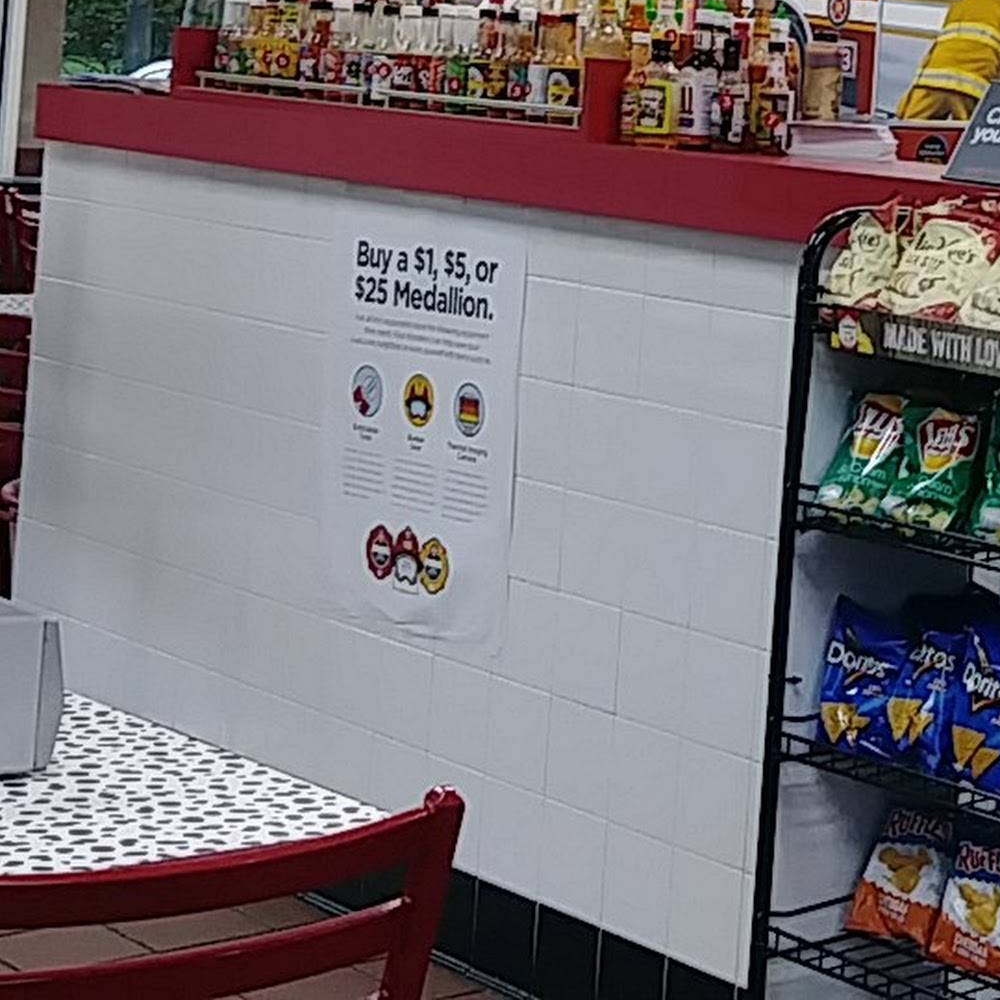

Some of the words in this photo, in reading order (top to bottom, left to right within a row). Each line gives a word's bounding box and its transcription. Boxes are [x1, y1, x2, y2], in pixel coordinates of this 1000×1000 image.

[356, 239, 393, 275] Buy
[396, 251, 409, 273] a
[413, 245, 439, 281] $1,
[444, 250, 472, 286] $5,
[475, 259, 500, 284] or
[354, 274, 388, 306] $25
[393, 279, 494, 321] Medallion.
[883, 321, 929, 354] MADE
[929, 329, 974, 367] WITH
